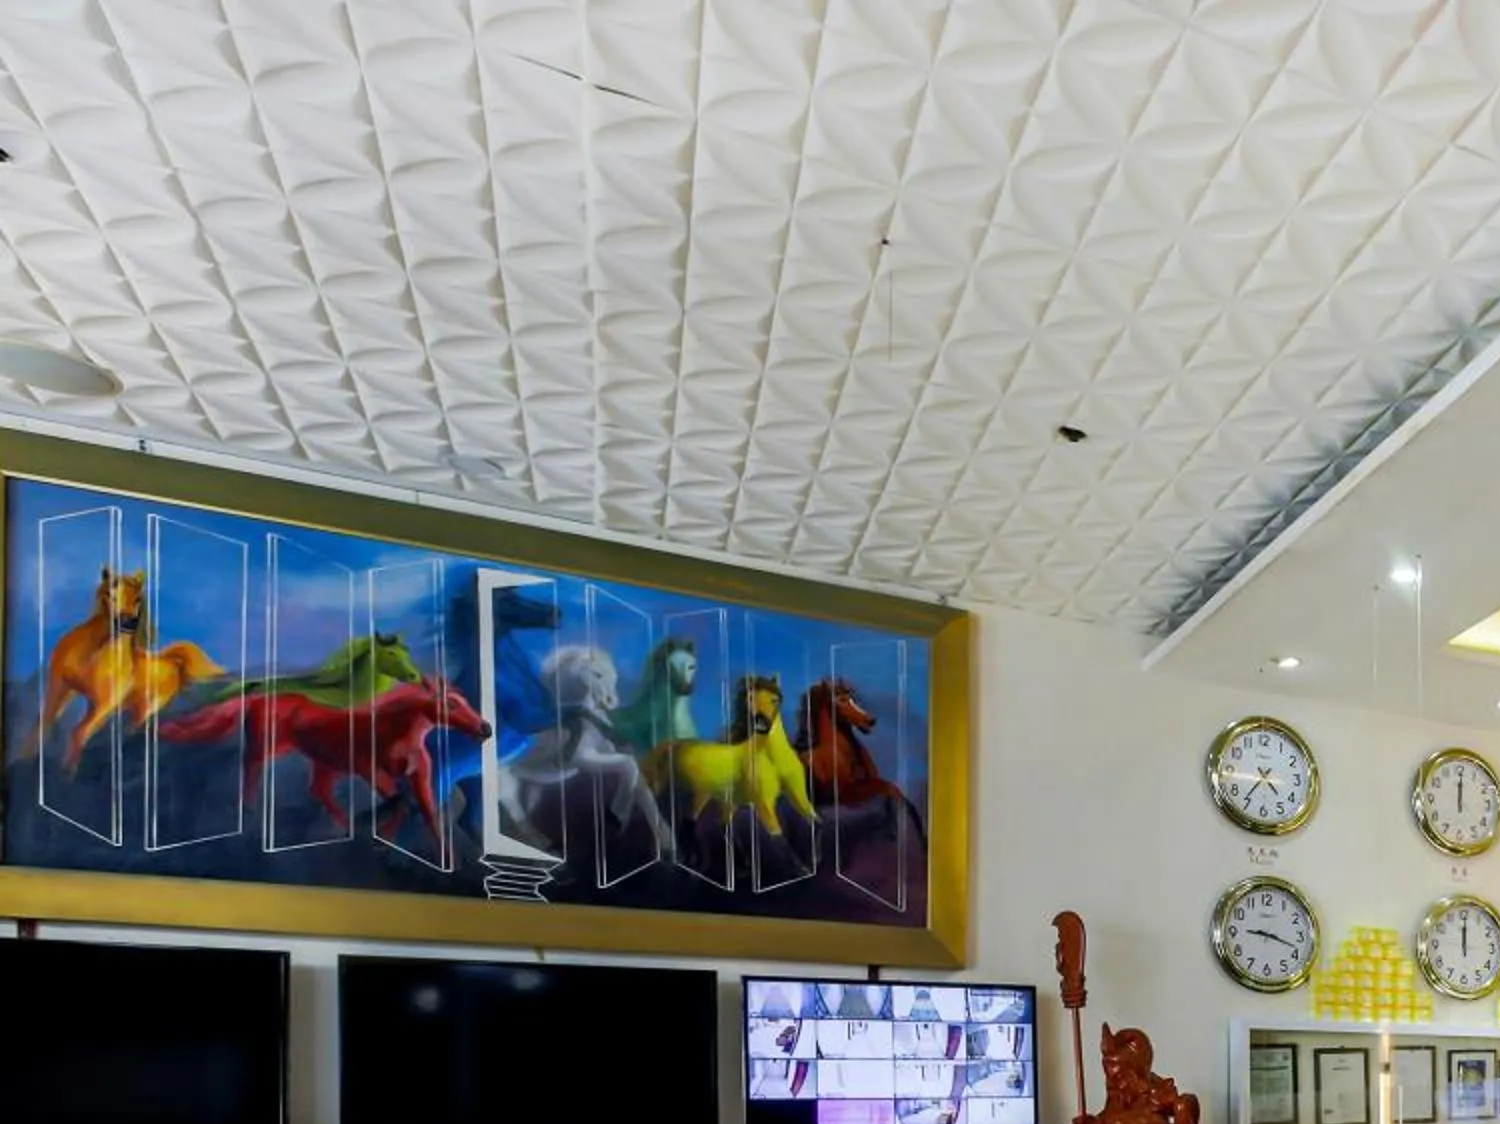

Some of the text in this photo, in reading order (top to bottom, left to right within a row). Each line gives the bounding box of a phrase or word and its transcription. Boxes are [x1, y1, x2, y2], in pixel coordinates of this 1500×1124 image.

[1243, 736, 1253, 748] 11
[1260, 734, 1271, 746] 12
[1279, 742, 1283, 753] 1
[1289, 755, 1297, 768] 2
[1292, 773, 1301, 787] 3
[1231, 783, 1239, 797] 8
[1287, 791, 1296, 803] 4
[1259, 805, 1268, 818] 6
[1276, 801, 1285, 815] 5
[1246, 897, 1255, 909] 11
[1261, 893, 1273, 906] 12
[1281, 900, 1286, 911] 1
[1233, 907, 1245, 921] 10
[1291, 912, 1300, 924] 2
[1228, 925, 1238, 938] 9
[1296, 931, 1304, 943] 3
[1233, 943, 1242, 956] 8
[1291, 948, 1299, 960] 4
[1246, 957, 1256, 970] 7
[1262, 963, 1271, 976] 6
[1280, 959, 1288, 973] 5
